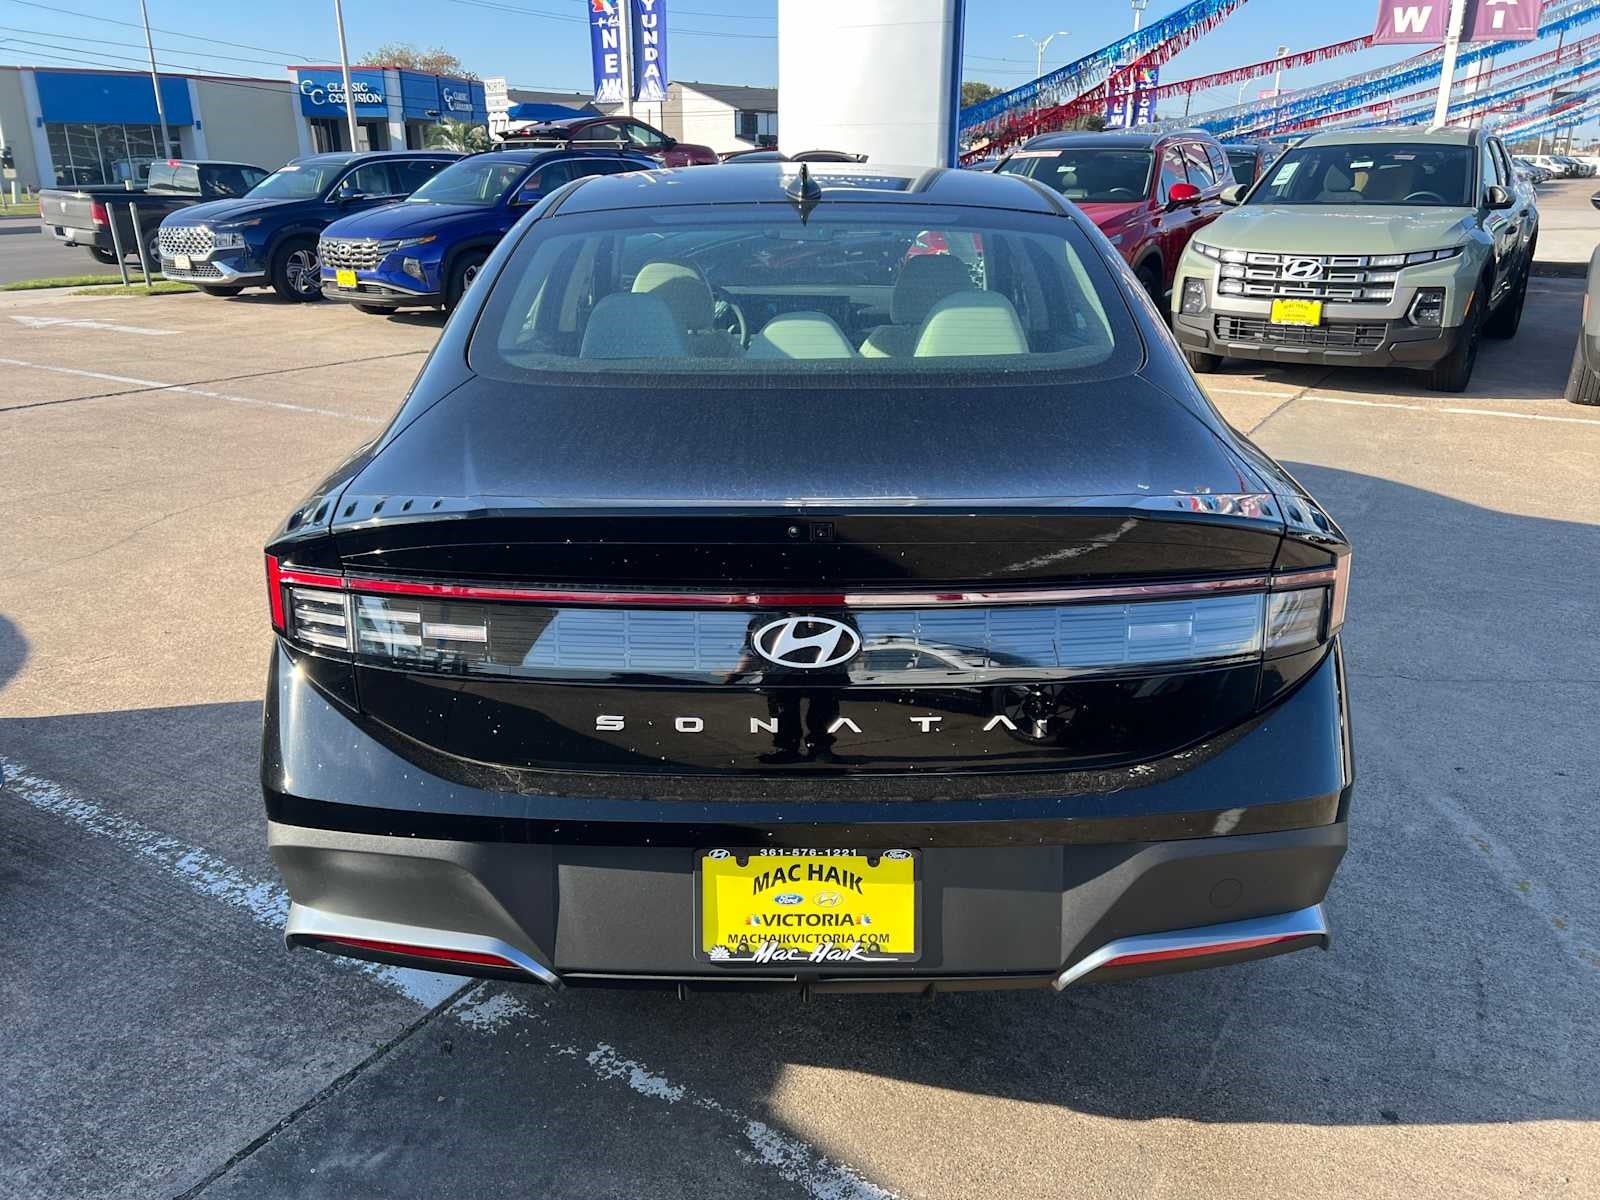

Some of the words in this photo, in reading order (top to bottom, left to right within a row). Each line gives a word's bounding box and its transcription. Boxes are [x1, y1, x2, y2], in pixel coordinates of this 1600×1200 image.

[601, 28, 623, 98] NEW
[594, 714, 1018, 734] SONATA
[760, 848, 858, 857] 361-576-1221
[752, 863, 801, 896] MAC
[807, 863, 863, 896] HAIK
[762, 913, 856, 927] VICTORIA
[727, 933, 890, 944] MACHAIKVICTORIA.COM
[752, 941, 808, 963] Mac
[808, 941, 869, 963] Haik
